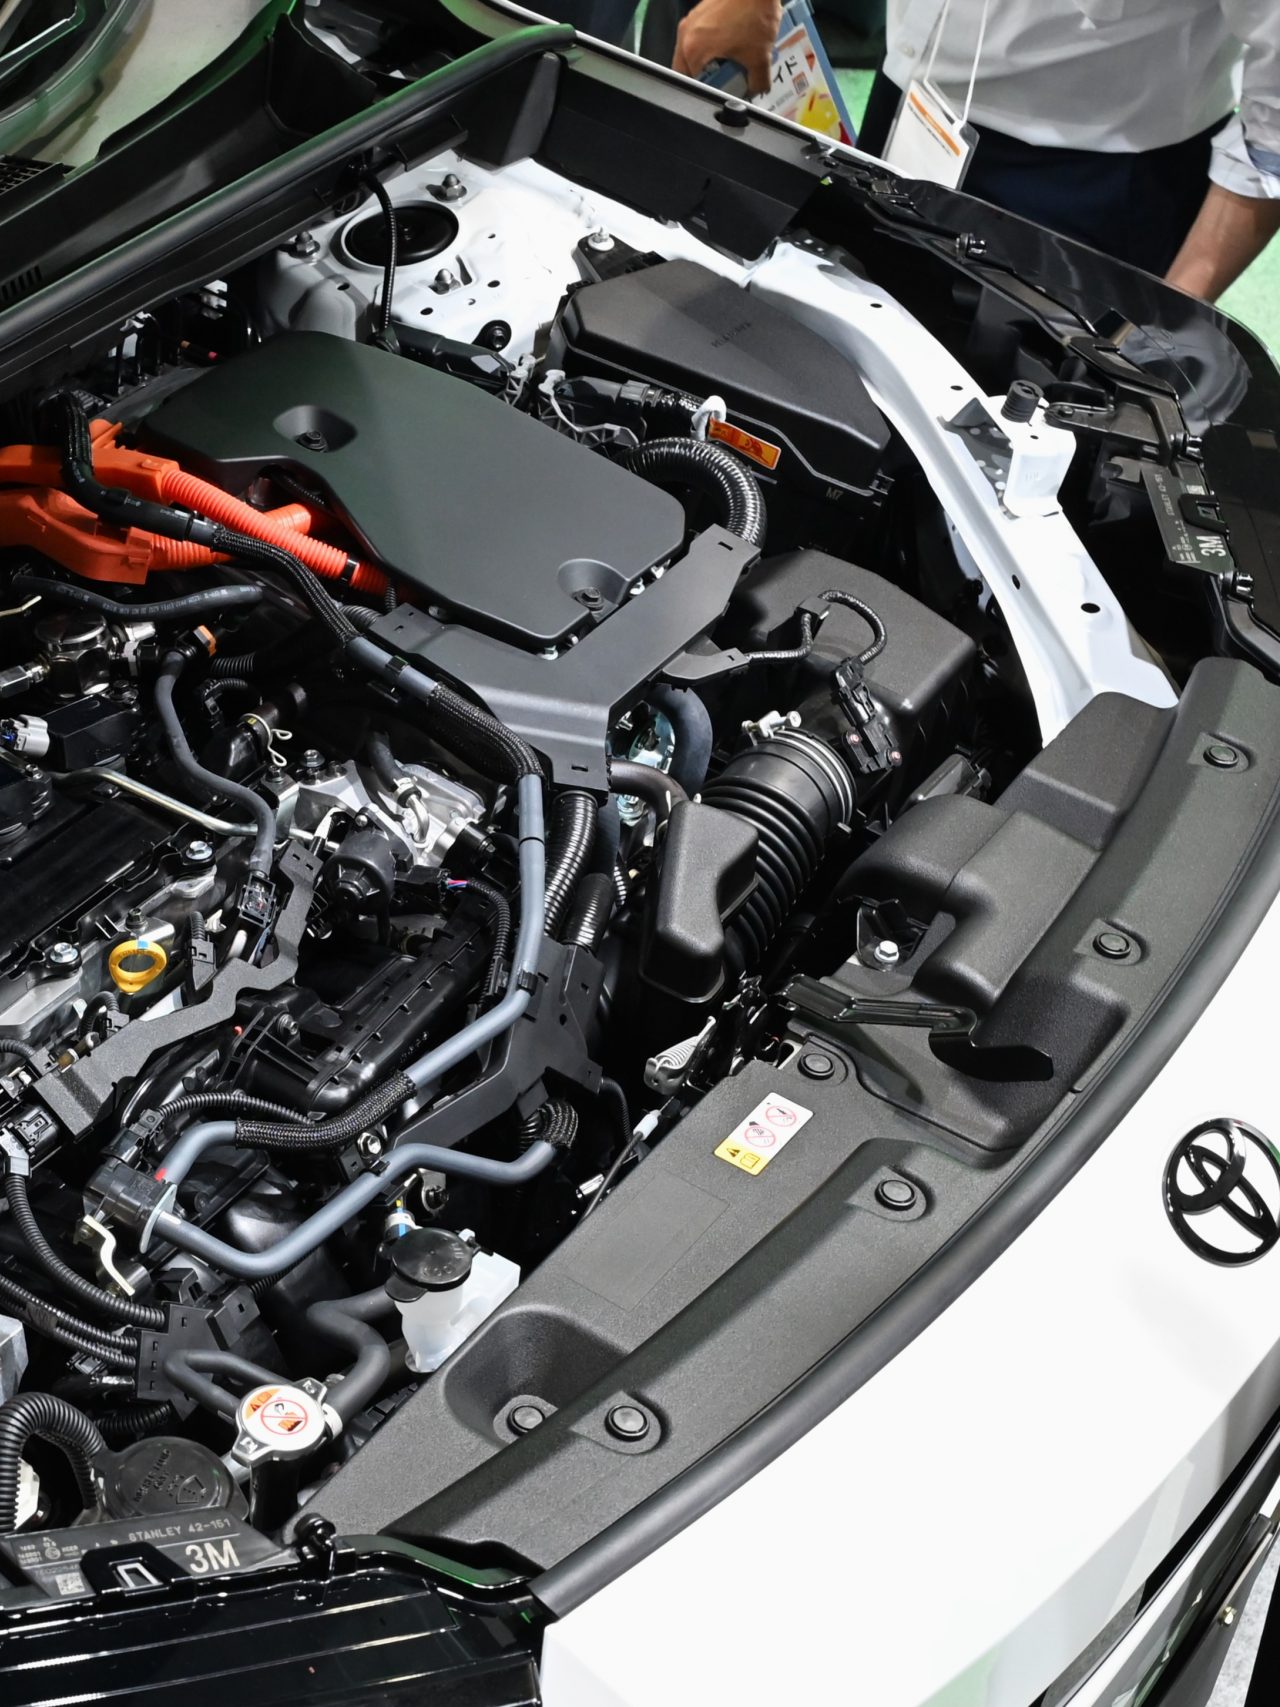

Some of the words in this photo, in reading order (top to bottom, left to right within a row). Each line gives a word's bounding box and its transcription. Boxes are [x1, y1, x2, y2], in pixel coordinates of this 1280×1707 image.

[1196, 535, 1227, 557] 3M
[128, 1524, 182, 1542] STANLEY
[188, 1517, 231, 1533] 42-151
[185, 1539, 241, 1573] 3M
